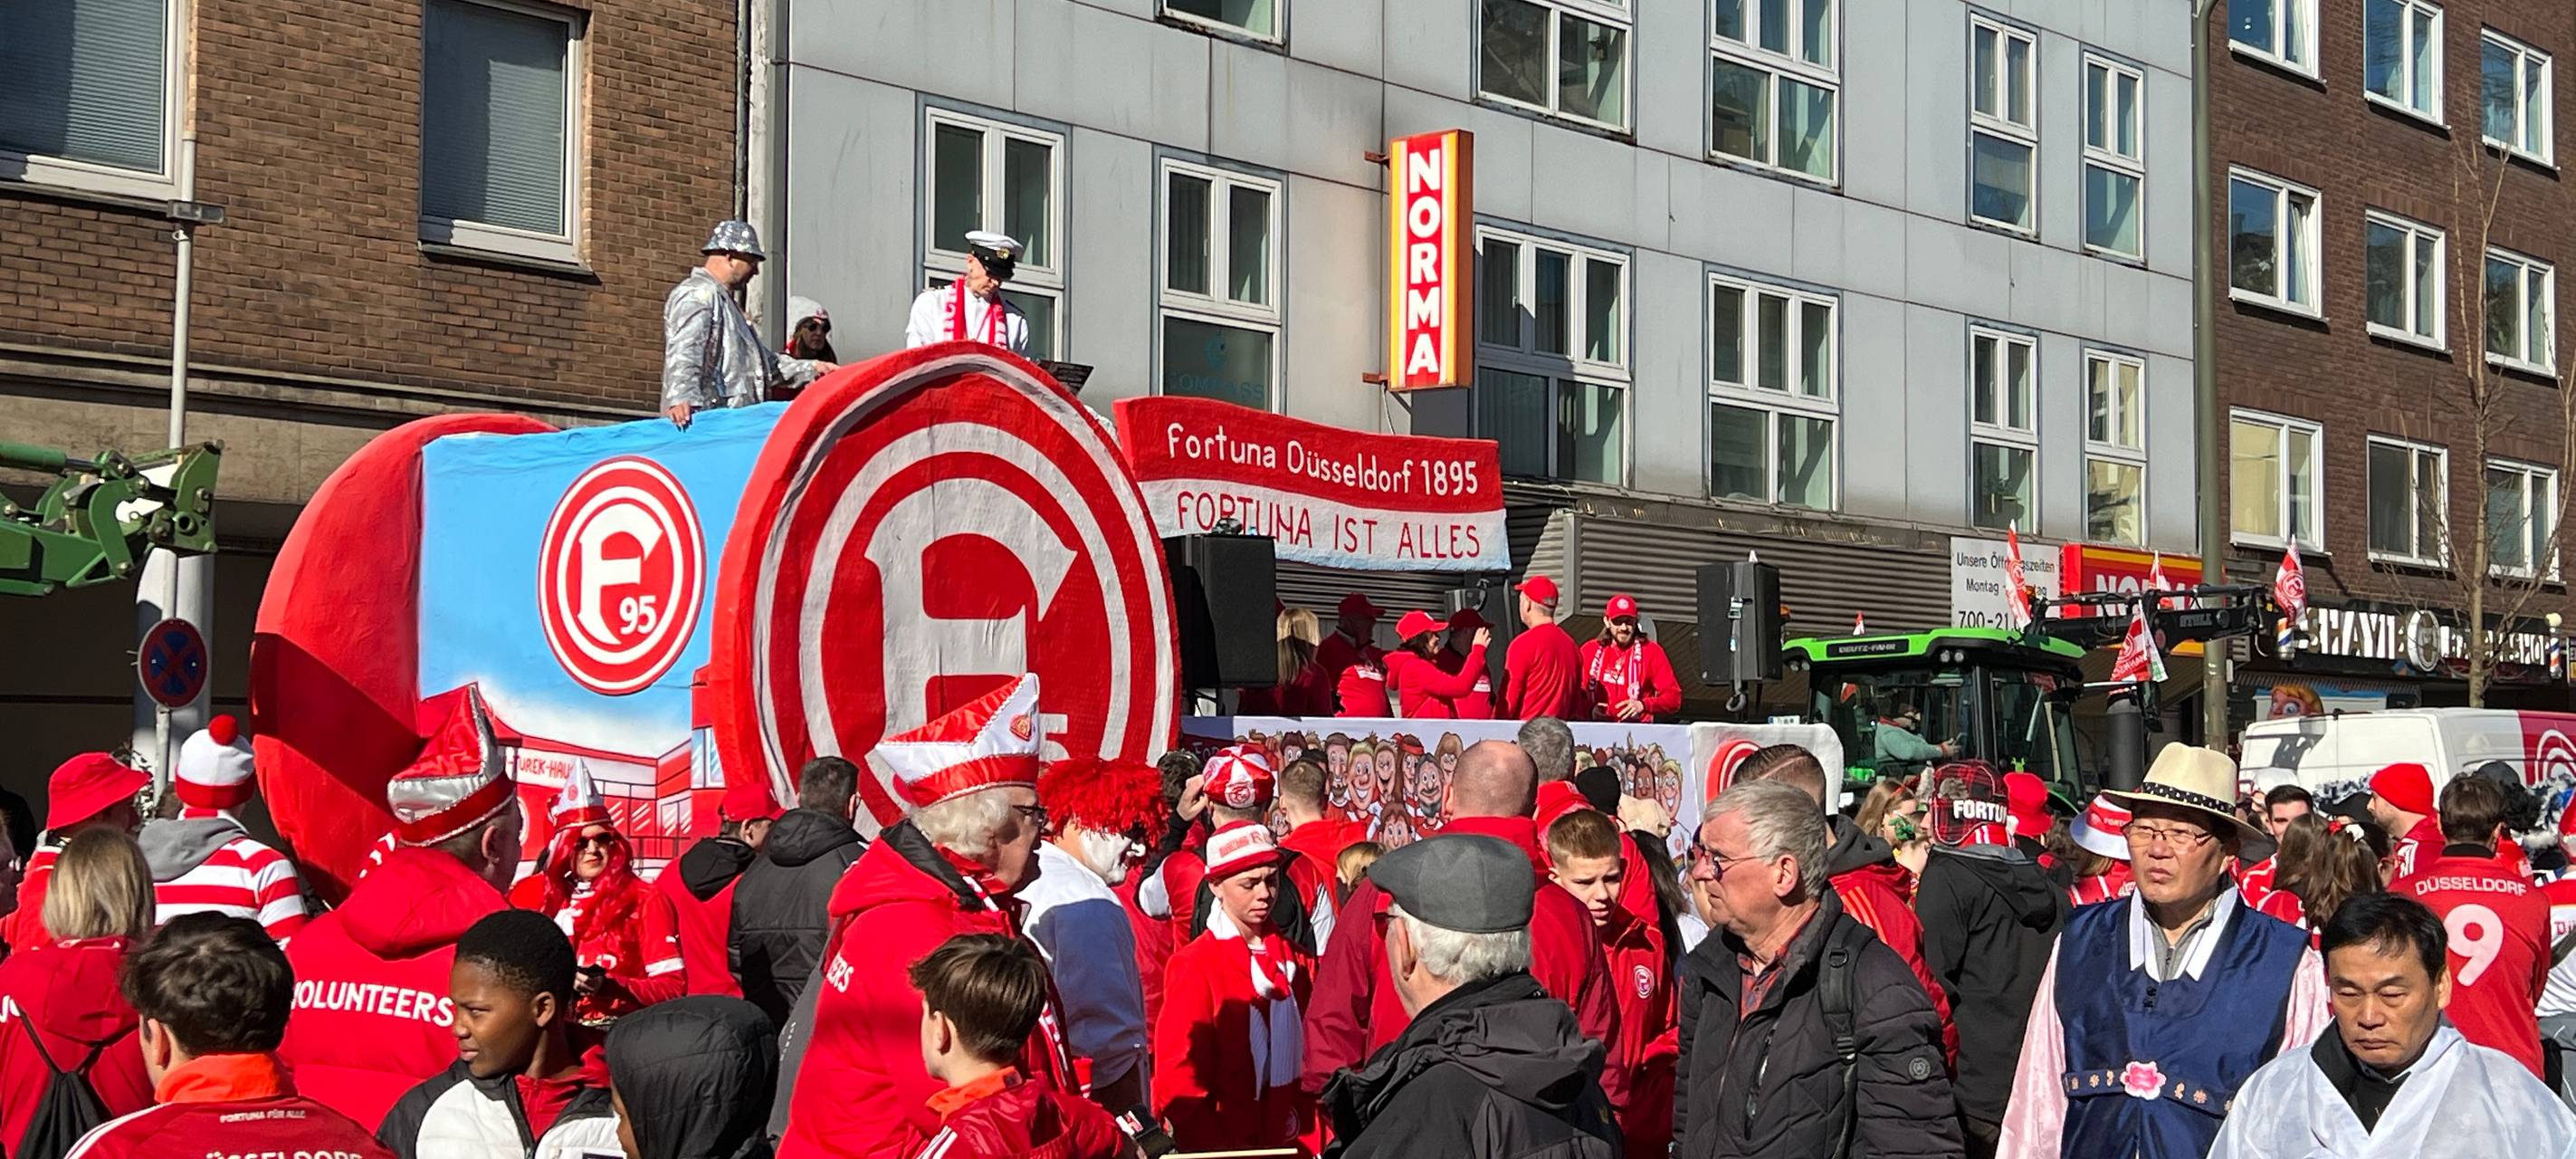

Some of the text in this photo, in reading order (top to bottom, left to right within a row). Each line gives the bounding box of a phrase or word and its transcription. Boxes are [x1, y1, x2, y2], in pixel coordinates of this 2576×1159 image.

[1407, 148, 1441, 375] NORMA
[1287, 440, 1413, 493] Düsseldorf
[1420, 460, 1478, 496] 1895
[1335, 514, 1379, 554] IST
[1398, 523, 1480, 560] ALLES
[1956, 551, 1988, 569] Unsere
[1966, 578, 1999, 596] Montag
[618, 595, 657, 636] 95
[1953, 799, 2008, 824] FORTU
[2415, 876, 2527, 896] DÜSSELDORF
[2444, 904, 2504, 987] 9
